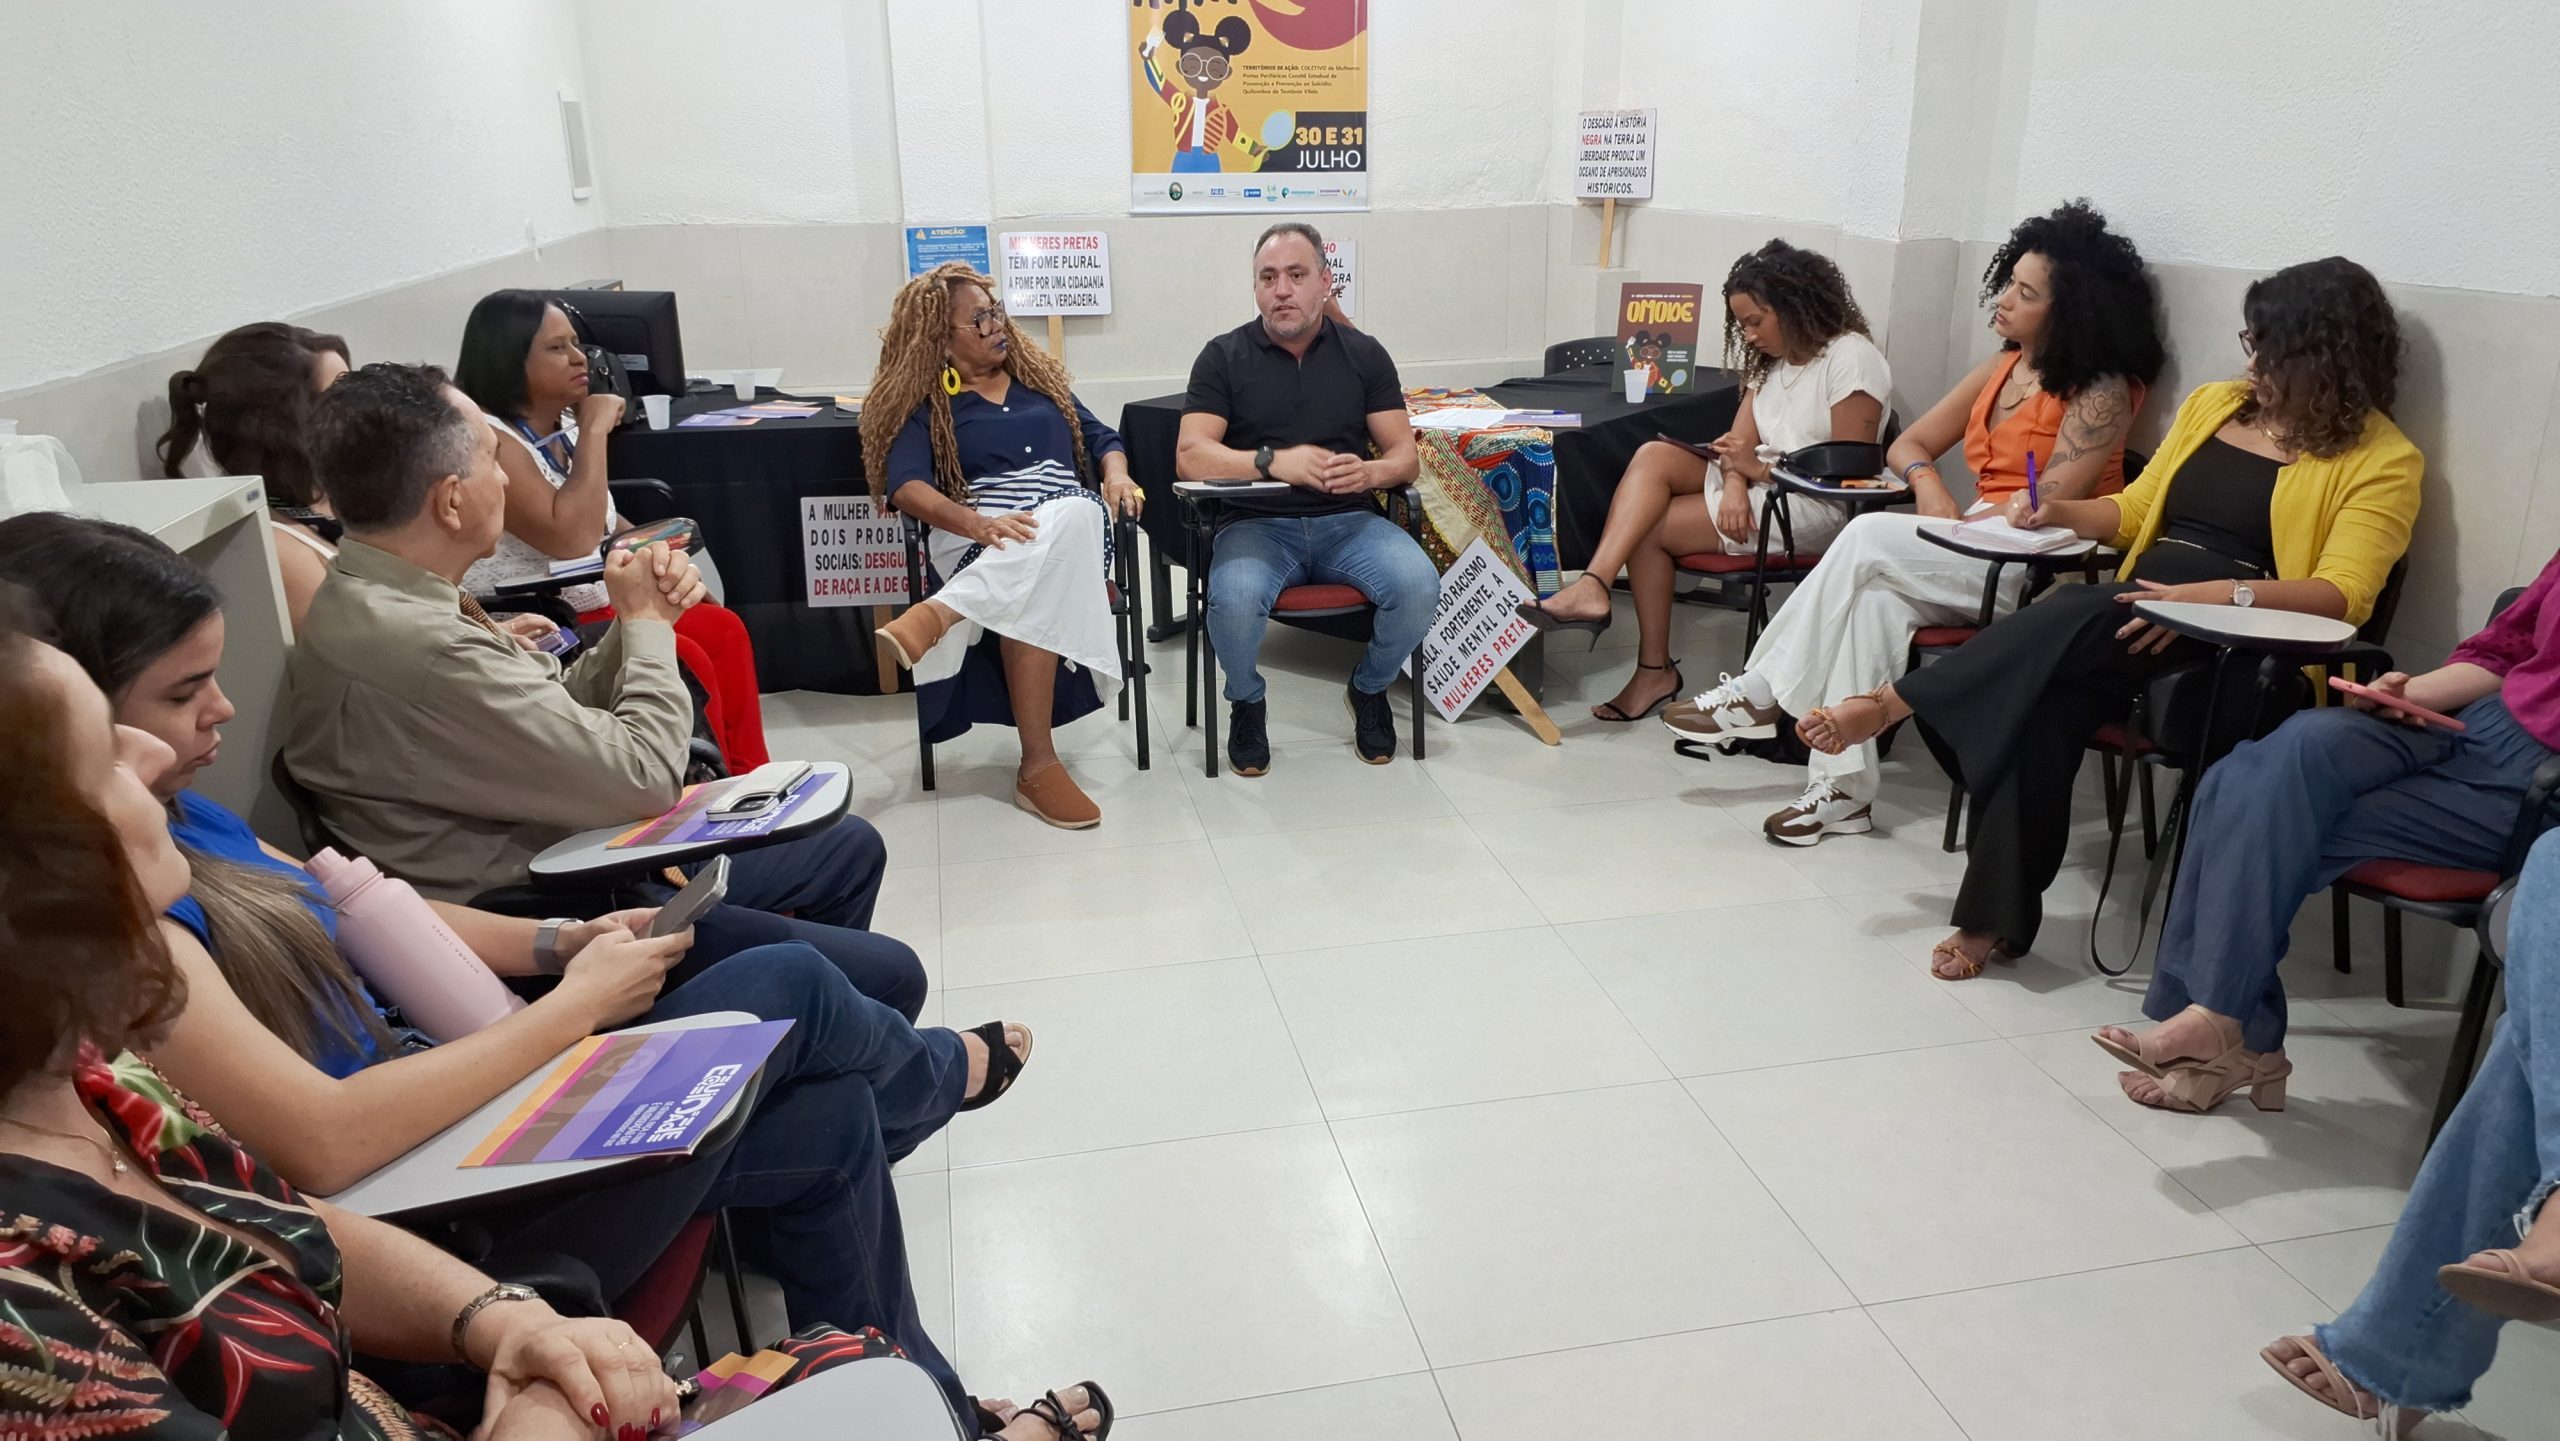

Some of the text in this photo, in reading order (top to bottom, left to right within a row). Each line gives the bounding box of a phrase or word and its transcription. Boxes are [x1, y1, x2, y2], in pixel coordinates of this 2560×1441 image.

[1583, 119, 1586, 129] O
[1588, 118, 1613, 129] DESCASO
[1620, 114, 1646, 128] HISTÓRIA
[1296, 127, 1362, 145] 30 E 31
[1582, 134, 1645, 145] NEGRA NA TERRA DA
[1296, 150, 1361, 169] JULHO
[1580, 150, 1645, 161] LIBERDADE PRODUZ UM
[1579, 167, 1646, 178] OCEANO DE APRISIONADOS
[1587, 180, 1634, 194] HISTÓRICOS.
[1009, 236, 1098, 250] MERES PRETAS
[1009, 253, 1101, 269] TÊM FOME PLURAL.
[1009, 276, 1104, 289] A FOME POR UMA CIDADANIA
[1055, 294, 1099, 307] VERDADEIRA.
[809, 505, 816, 521] A
[824, 503, 869, 520] MULHER
[811, 529, 846, 546] DOIS
[816, 554, 862, 570] SOCIAIS:
[815, 579, 828, 596] DE
[832, 578, 861, 599] RAÇA
[865, 578, 870, 594] E
[874, 577, 880, 594] A
[884, 576, 898, 593] DE
[1440, 593, 1454, 615] DO
[1452, 555, 1487, 601] RACISMO
[1440, 585, 1496, 646] FORTEMENTE,
[1492, 572, 1504, 588] A
[1427, 590, 1520, 695] SAÚDE MENTAL DAS
[1442, 653, 1494, 713] MULHERES
